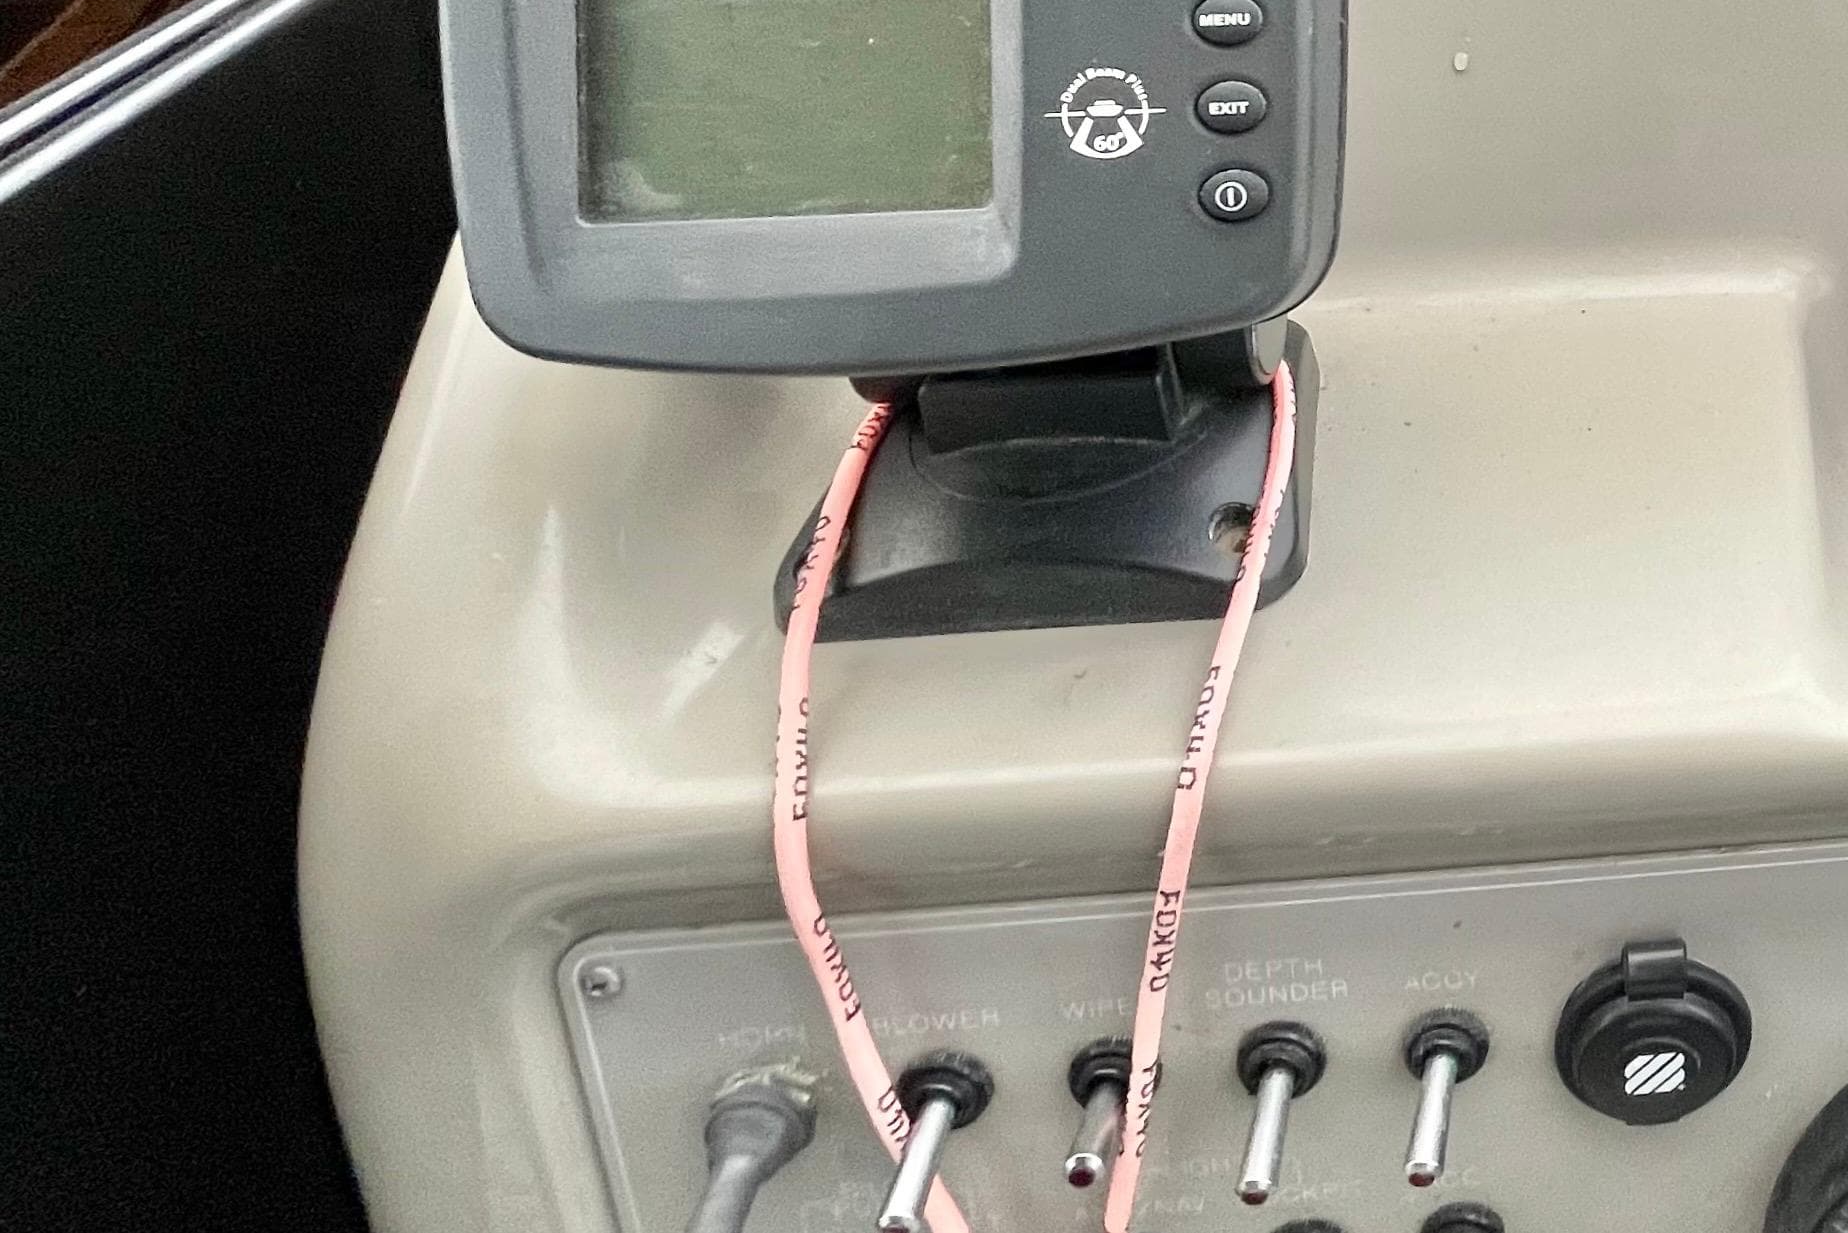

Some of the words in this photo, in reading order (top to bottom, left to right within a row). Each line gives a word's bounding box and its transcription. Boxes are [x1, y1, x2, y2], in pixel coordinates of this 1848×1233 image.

[1198, 12, 1251, 28] MENU
[1207, 100, 1250, 117] EXIT
[1225, 958, 1325, 985] DEPTH
[1204, 978, 1350, 1009] SOUNDER
